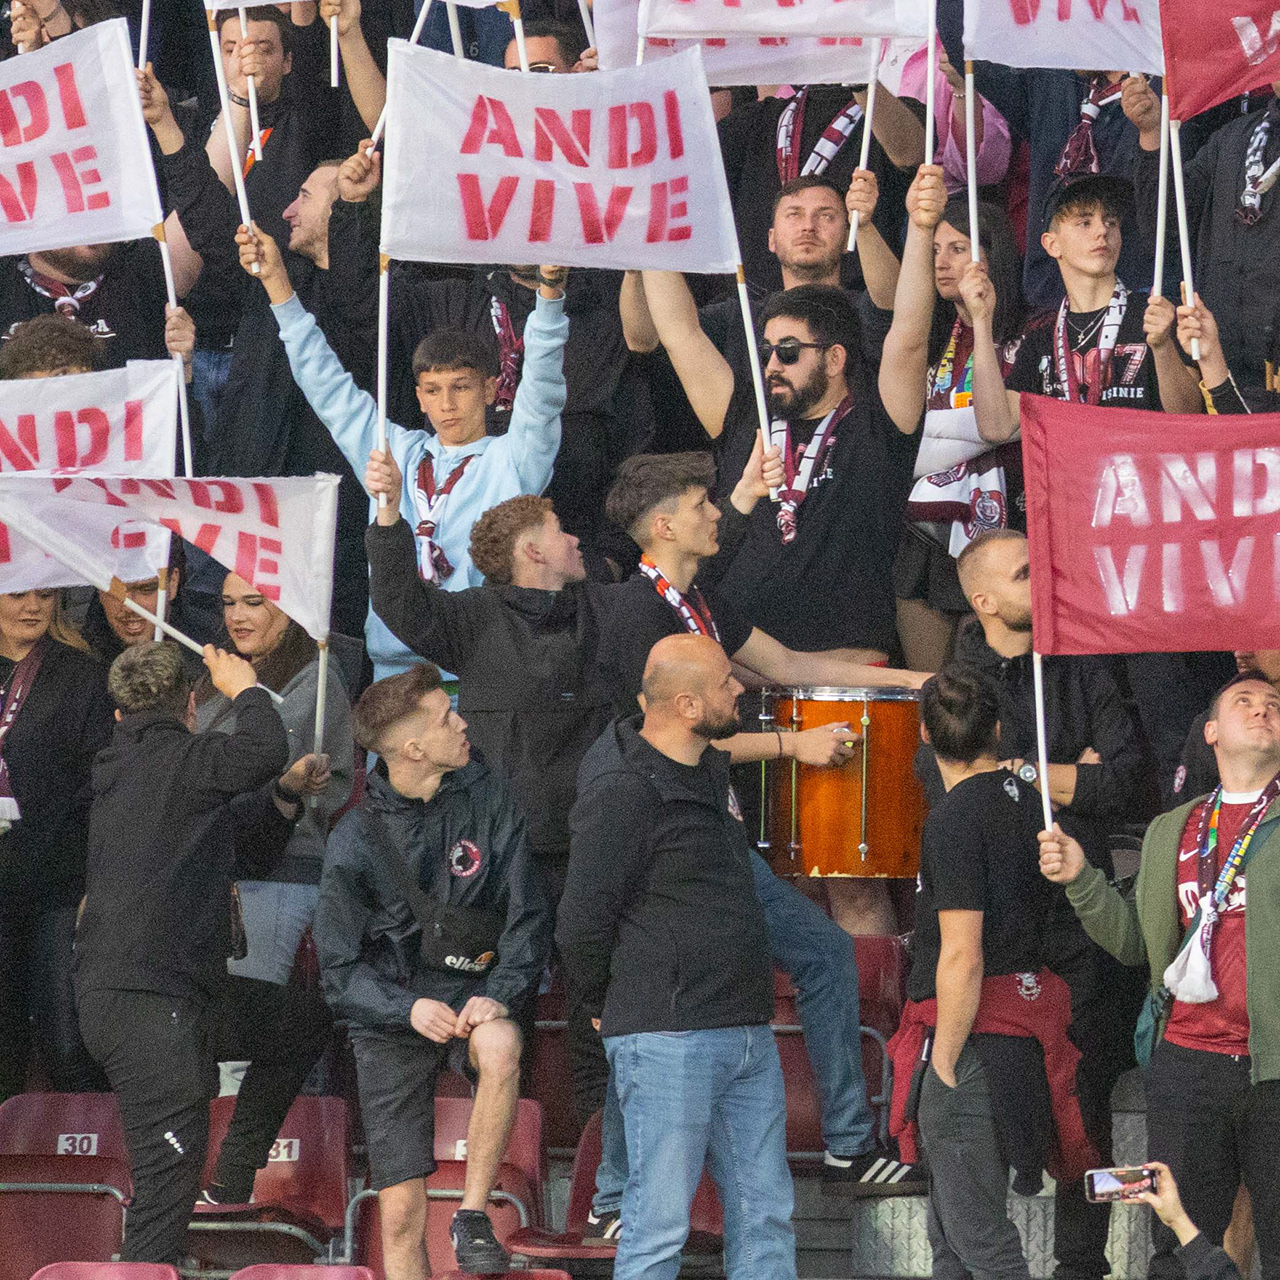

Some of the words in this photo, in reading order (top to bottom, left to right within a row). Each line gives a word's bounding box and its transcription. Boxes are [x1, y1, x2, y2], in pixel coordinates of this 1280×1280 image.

[460, 89, 683, 170] ANDI
[457, 173, 692, 245] VIVE
[1102, 387, 1144, 399] IȘINIE
[63, 1135, 91, 1154] 30
